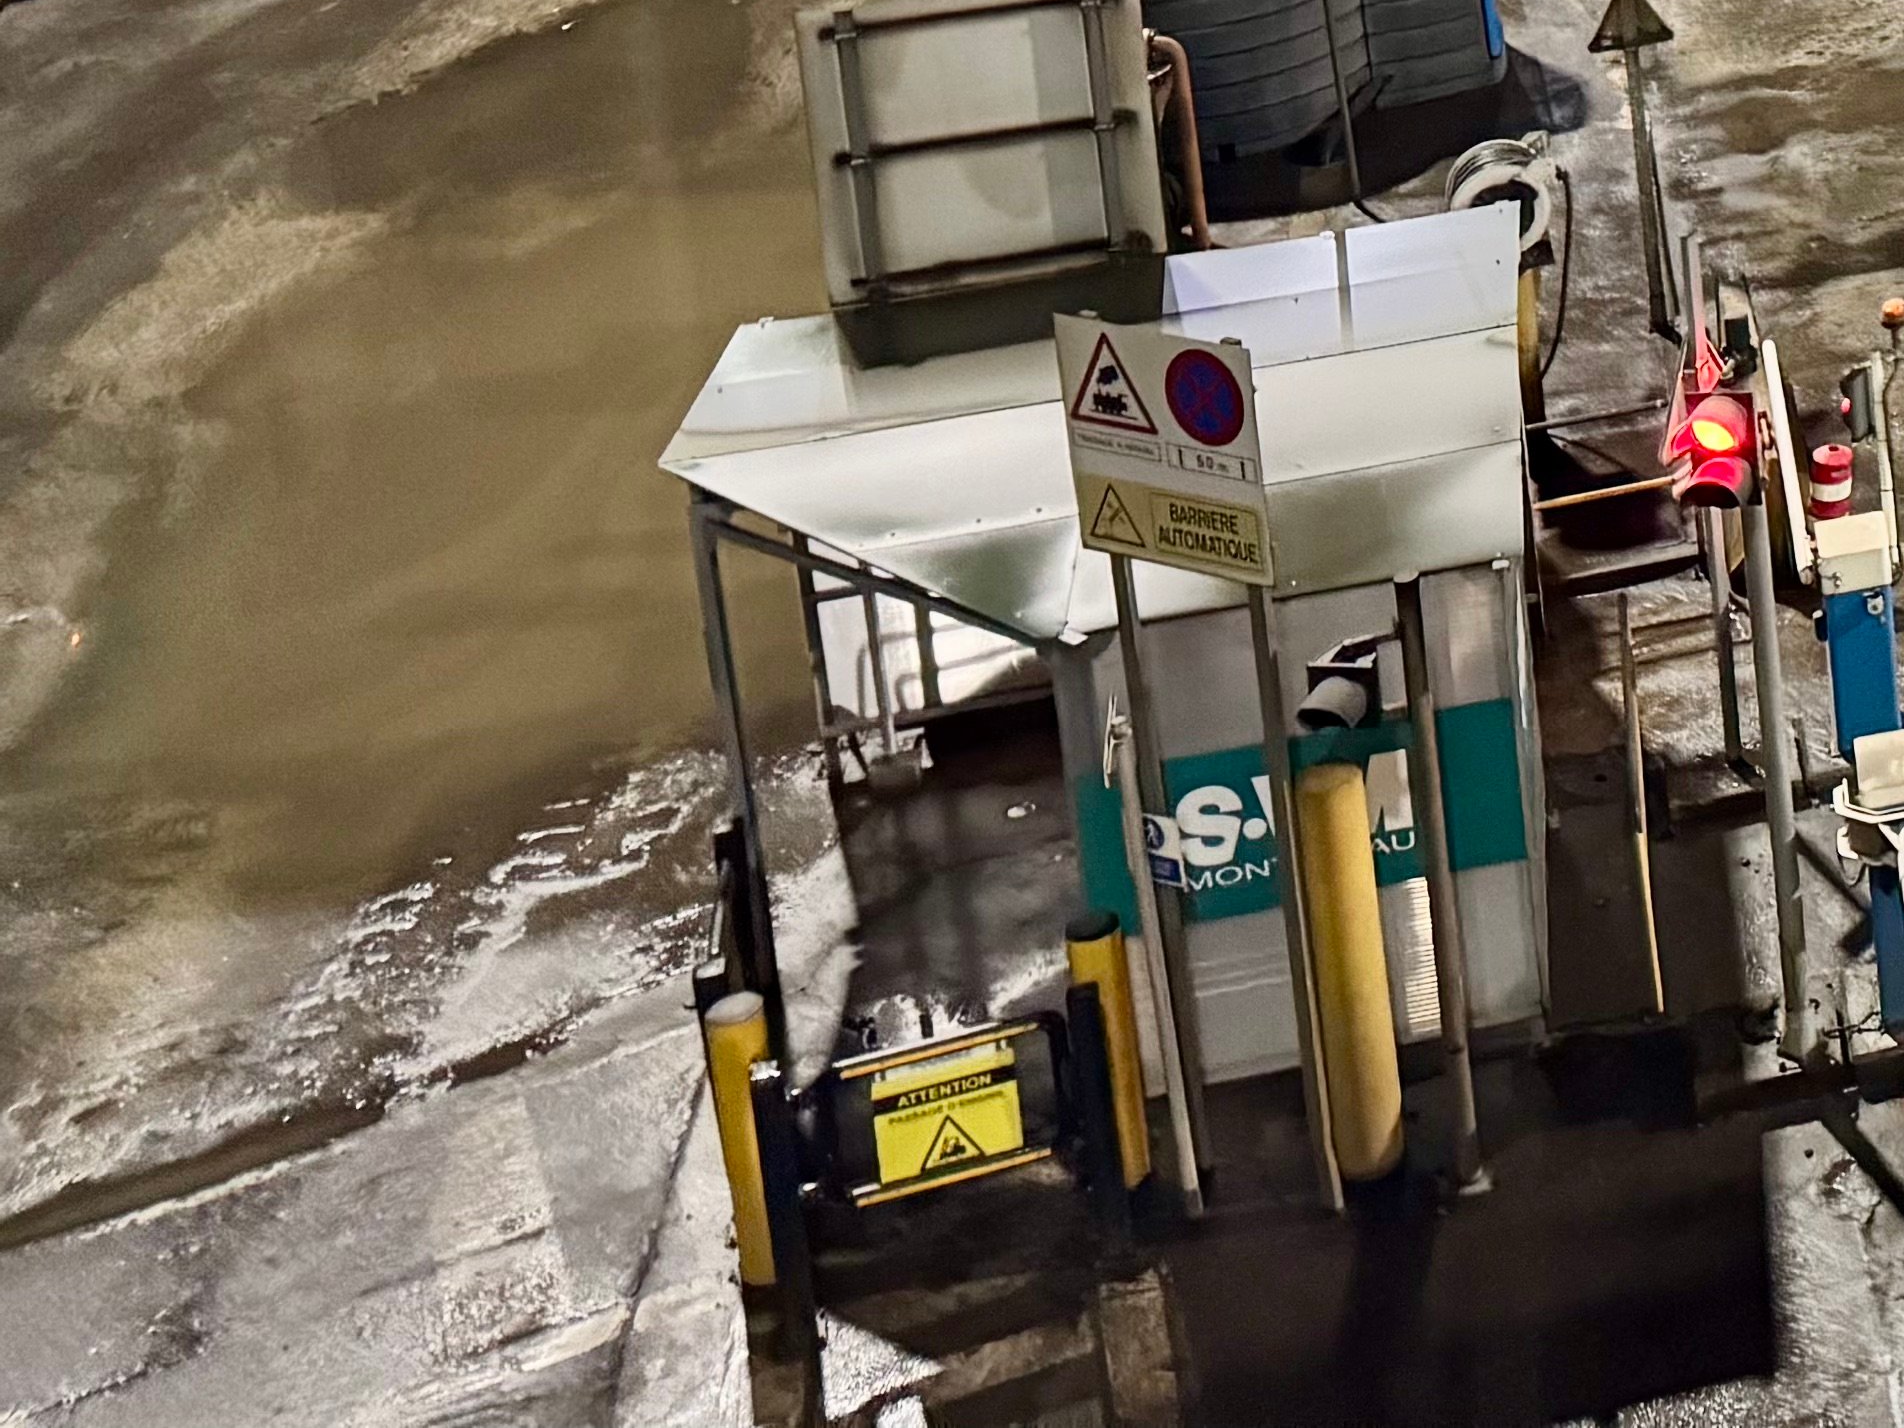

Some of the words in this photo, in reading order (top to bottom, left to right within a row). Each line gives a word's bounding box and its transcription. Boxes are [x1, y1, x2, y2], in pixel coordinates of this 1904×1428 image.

[1168, 502, 1239, 536] BARRIERE
[1158, 525, 1259, 564] AUTOMATIQUE
[897, 1072, 993, 1108] ATTENTION
